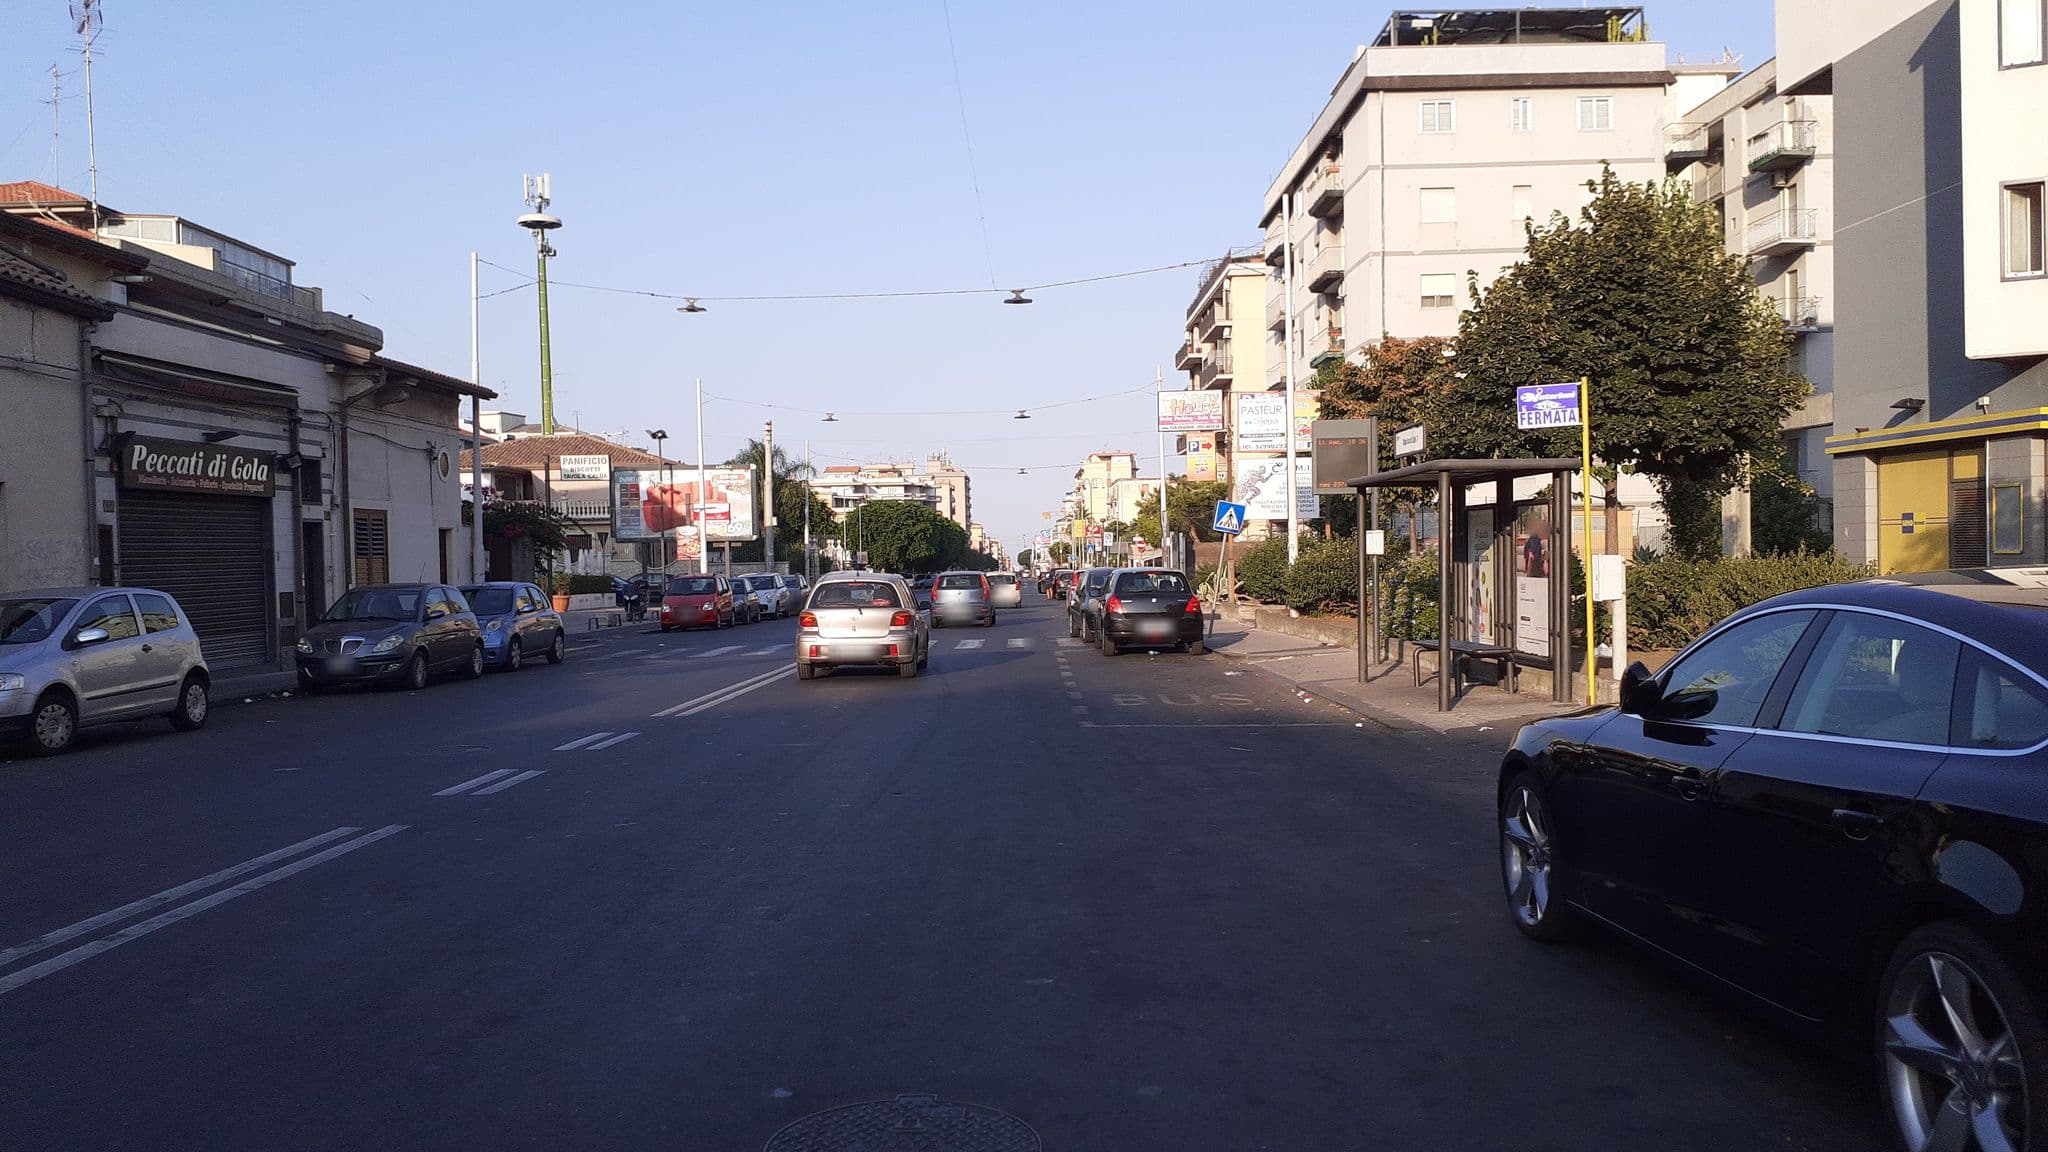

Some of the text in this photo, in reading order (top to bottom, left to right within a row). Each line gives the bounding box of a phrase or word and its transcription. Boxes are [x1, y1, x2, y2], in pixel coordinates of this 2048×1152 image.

[1240, 405, 1282, 415] PASTEUR
[1520, 409, 1576, 425] FERMATA
[131, 444, 268, 481] Peccati di Gola
[562, 457, 607, 465] PANIFICIO
